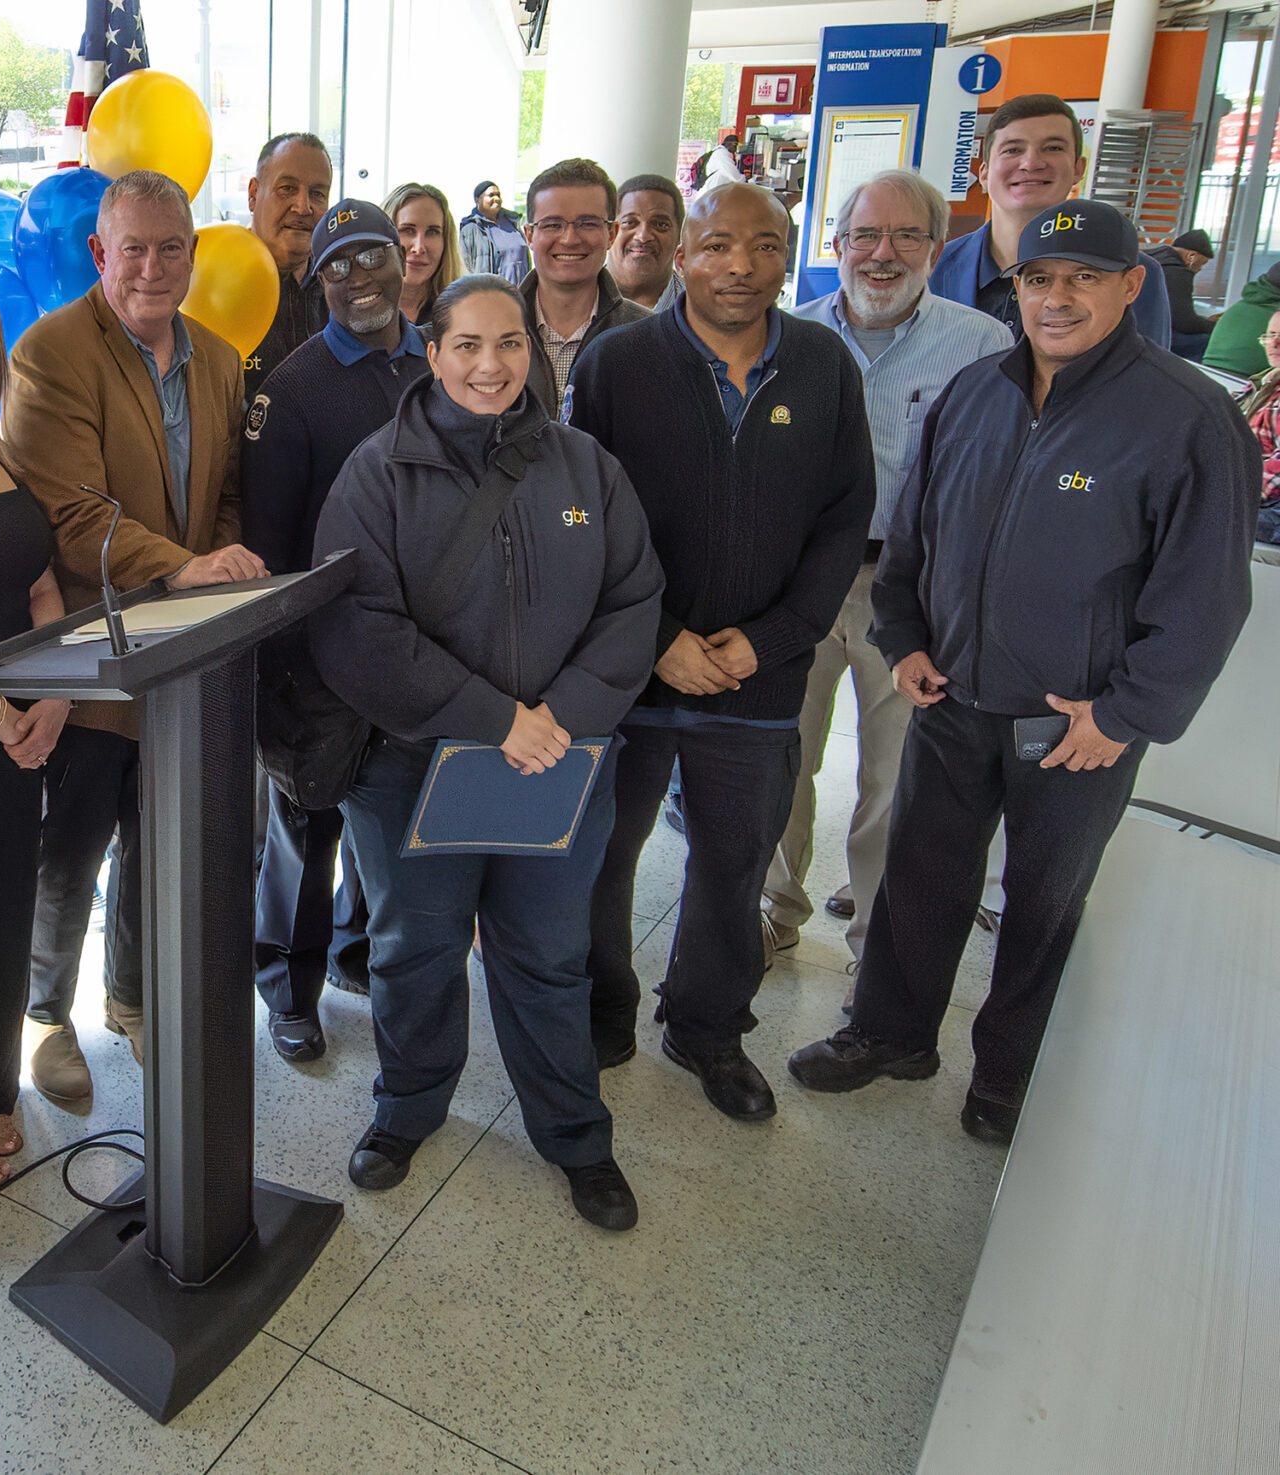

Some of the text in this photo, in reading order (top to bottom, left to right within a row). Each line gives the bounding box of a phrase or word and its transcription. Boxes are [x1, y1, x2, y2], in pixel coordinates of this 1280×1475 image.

[827, 48, 923, 60] INTERMODAL TRANSPORTATION
[826, 62, 870, 72] INFORMATION
[950, 110, 977, 193] INFORMATION
[327, 209, 359, 234] gbt
[1039, 211, 1087, 238] gbt
[1058, 470, 1096, 492] gbt
[562, 505, 590, 527] gbt
